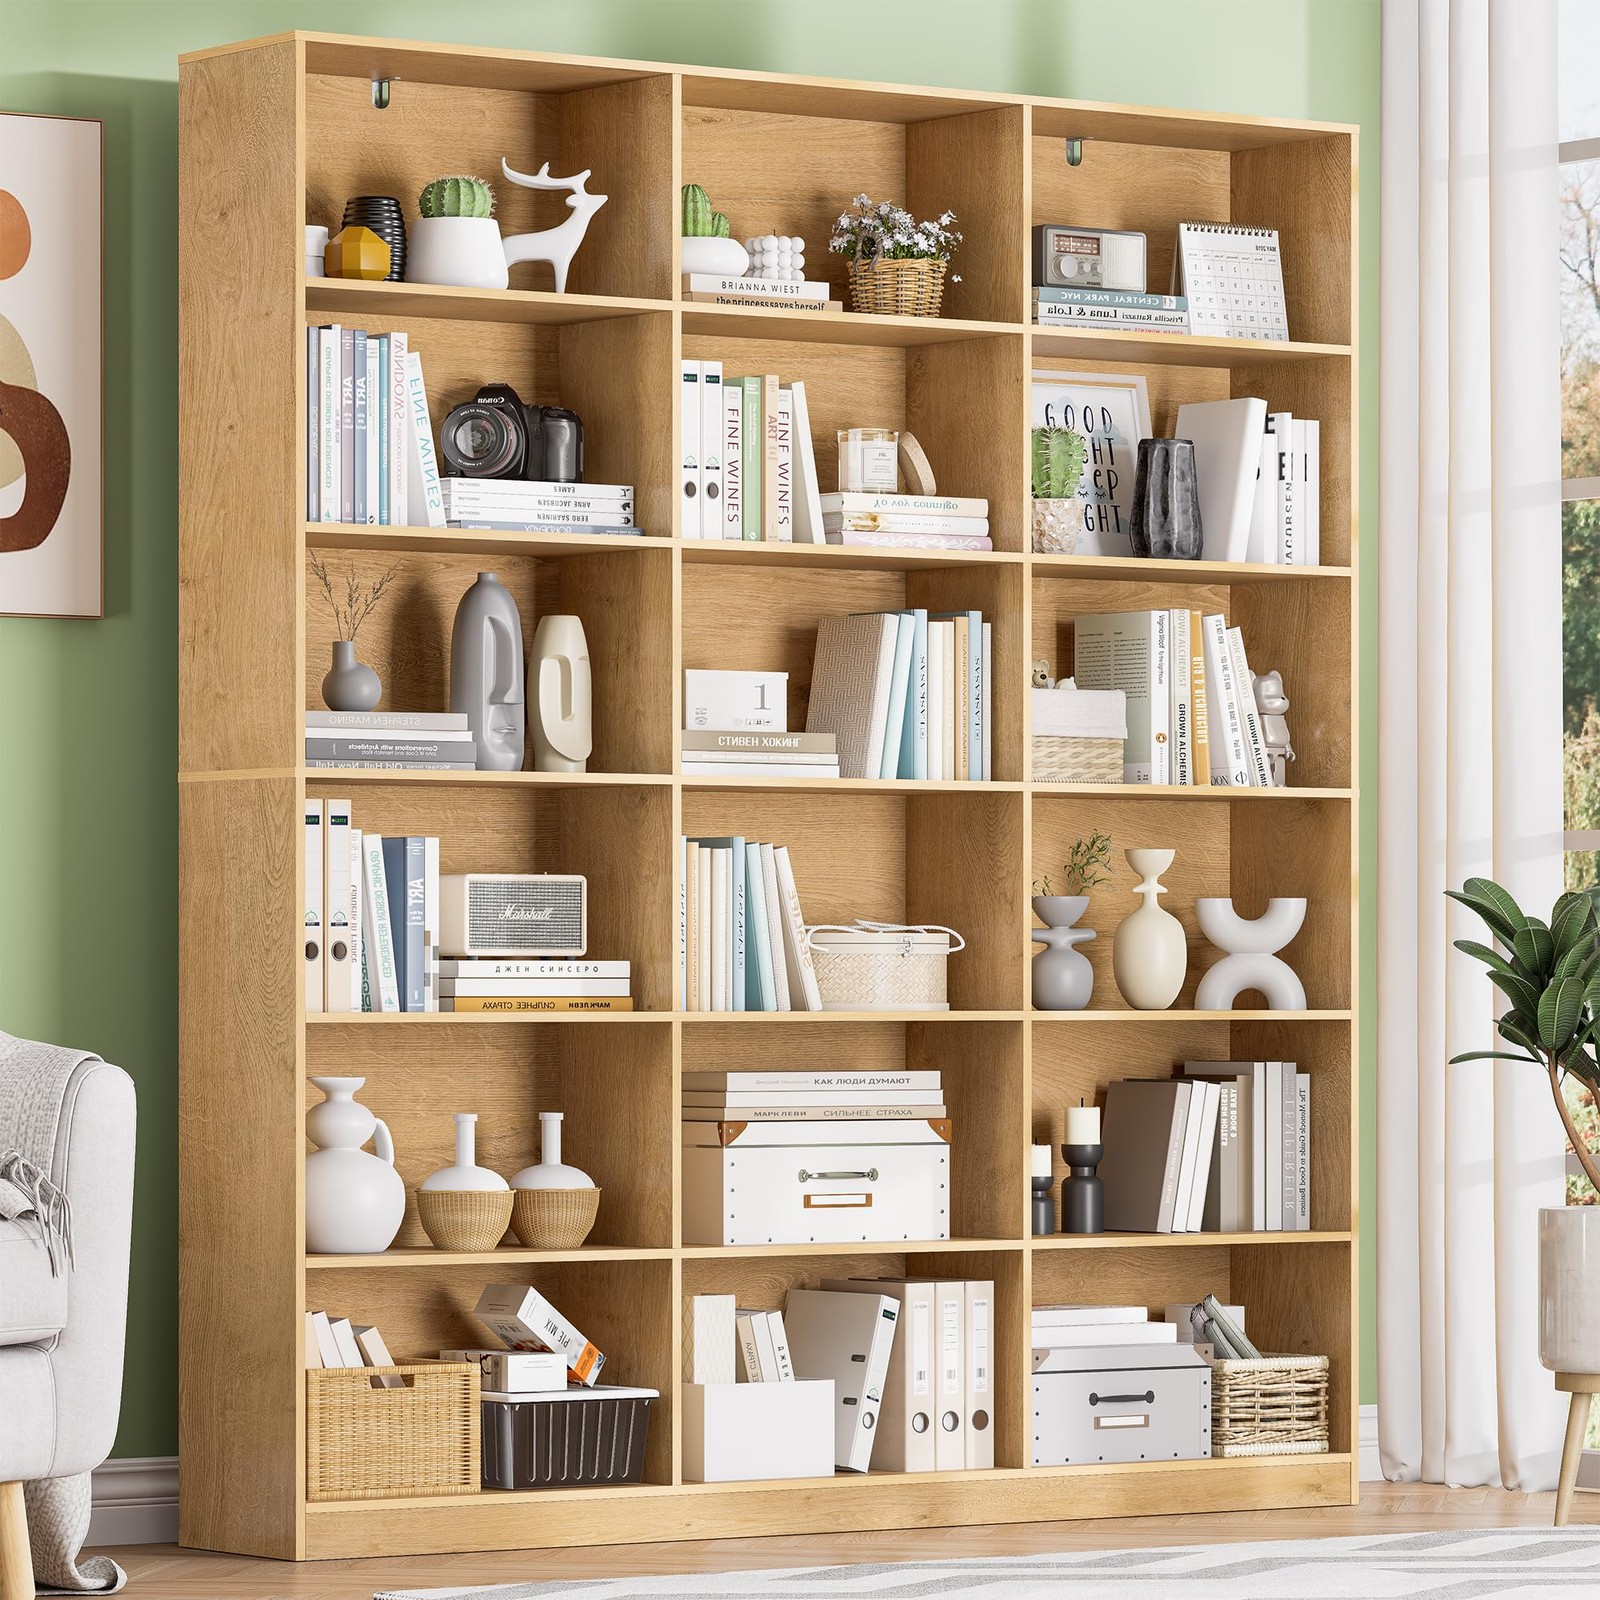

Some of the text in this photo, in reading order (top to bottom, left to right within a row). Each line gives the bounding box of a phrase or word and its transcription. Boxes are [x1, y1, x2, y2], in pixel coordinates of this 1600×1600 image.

[721, 280, 800, 294] BRIANNA WIEST
[727, 408, 739, 450] FINE
[768, 414, 778, 442] ART
[1044, 403, 1113, 434] GOOD
[778, 411, 789, 525] FINE WINES
[537, 499, 591, 508] ARNE JACOBSEN
[553, 485, 576, 494] EAMES
[727, 460, 739, 523] WINES
[536, 513, 570, 522] SAARINEN
[1157, 614, 1166, 634] Virginia
[1158, 634, 1166, 649] Woolf
[1178, 638, 1186, 688] ALCHEMIST
[1192, 656, 1205, 674] arts
[1233, 656, 1250, 699] ALCHEMIST
[753, 682, 772, 710] 1
[1194, 689, 1208, 744] architecture
[718, 736, 802, 748] СТИВЕН ХОКИНГ
[1178, 703, 1186, 786] GROWN ALCHEMIS
[1246, 713, 1268, 787] GROWN ALCHEMIS
[499, 903, 554, 920] Marshall
[835, 1078, 866, 1086] ЛЮДИ
[868, 1078, 911, 1086] ДУМАЮТ
[543, 1318, 571, 1349] PIE MIX
[777, 1346, 790, 1378] ДЖЕН
